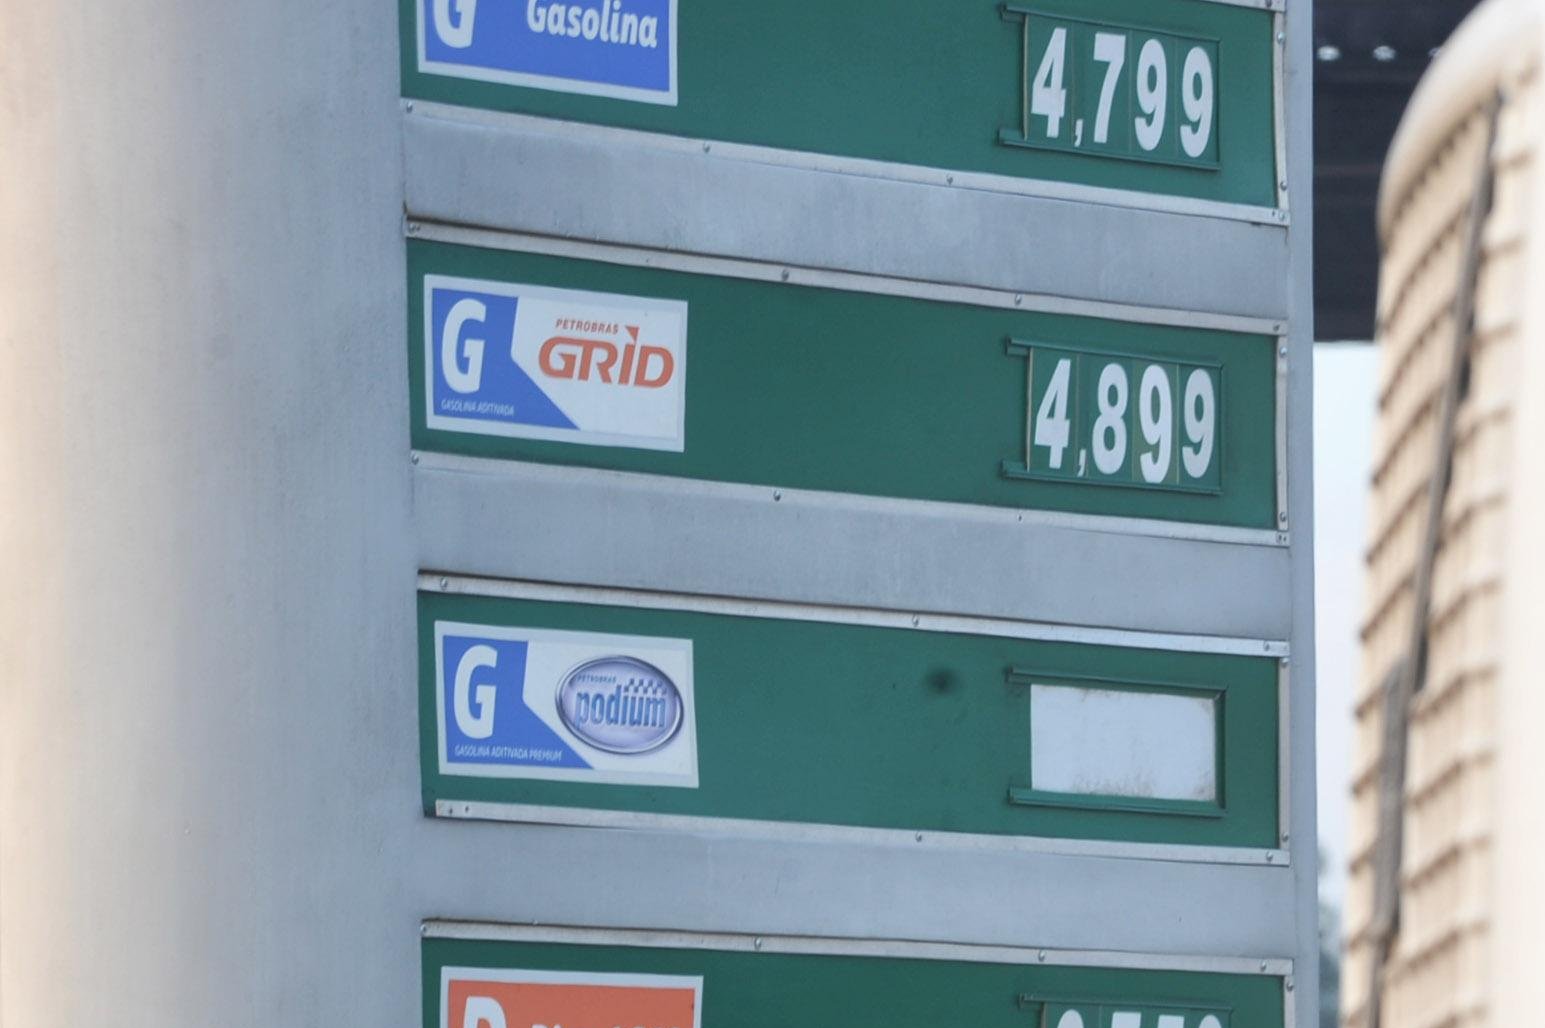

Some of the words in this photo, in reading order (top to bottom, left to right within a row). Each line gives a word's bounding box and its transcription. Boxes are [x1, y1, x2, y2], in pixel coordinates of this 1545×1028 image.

[526, 0, 659, 49] Gasolina
[1030, 27, 1214, 158] 4,799
[441, 298, 487, 394] G
[538, 326, 675, 389] GRID
[555, 318, 619, 335] PETROBRAS
[1034, 359, 1216, 484] 4,899
[453, 644, 499, 740] G
[575, 683, 666, 730] podium
[454, 745, 490, 758] GASOLINA
[490, 746, 529, 759] ADITIVADA
[529, 749, 563, 762] PREMIUM
